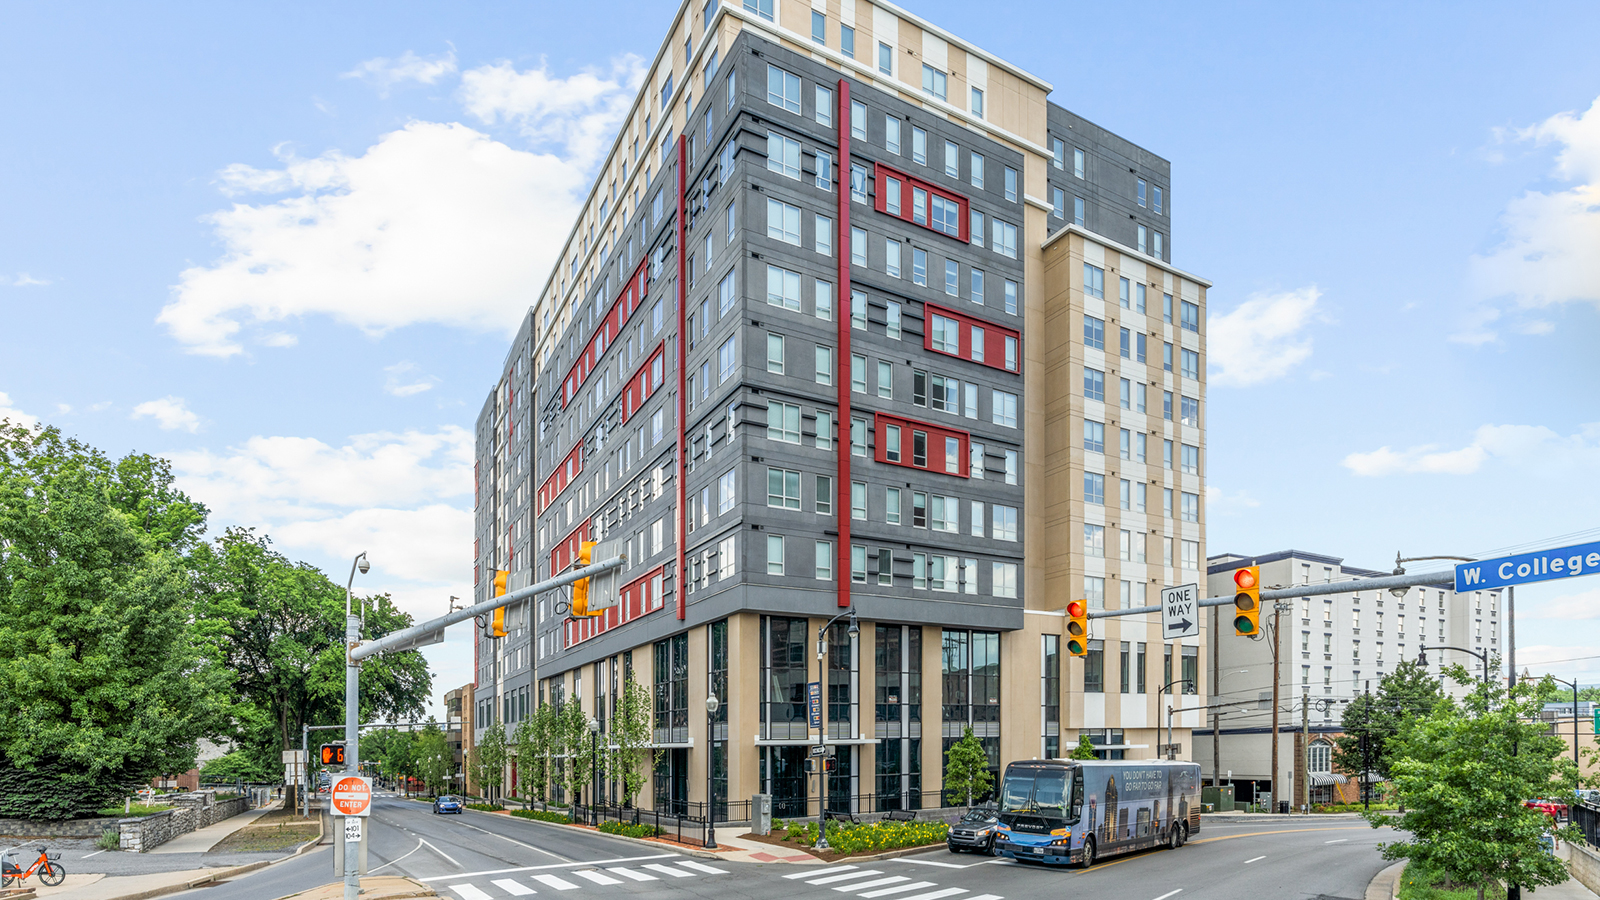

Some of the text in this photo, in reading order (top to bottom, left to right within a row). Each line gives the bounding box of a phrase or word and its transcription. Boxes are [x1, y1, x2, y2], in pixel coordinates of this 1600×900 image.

[1463, 552, 1600, 585] W. College
[1168, 589, 1191, 604] ONE
[1168, 602, 1192, 618] WAY
[337, 748, 343, 762] 6
[1122, 770, 1132, 780] YOU
[1146, 770, 1156, 779] HAVE
[1157, 770, 1162, 779] TO
[1125, 780, 1162, 791] GO FAR TO GO FAR
